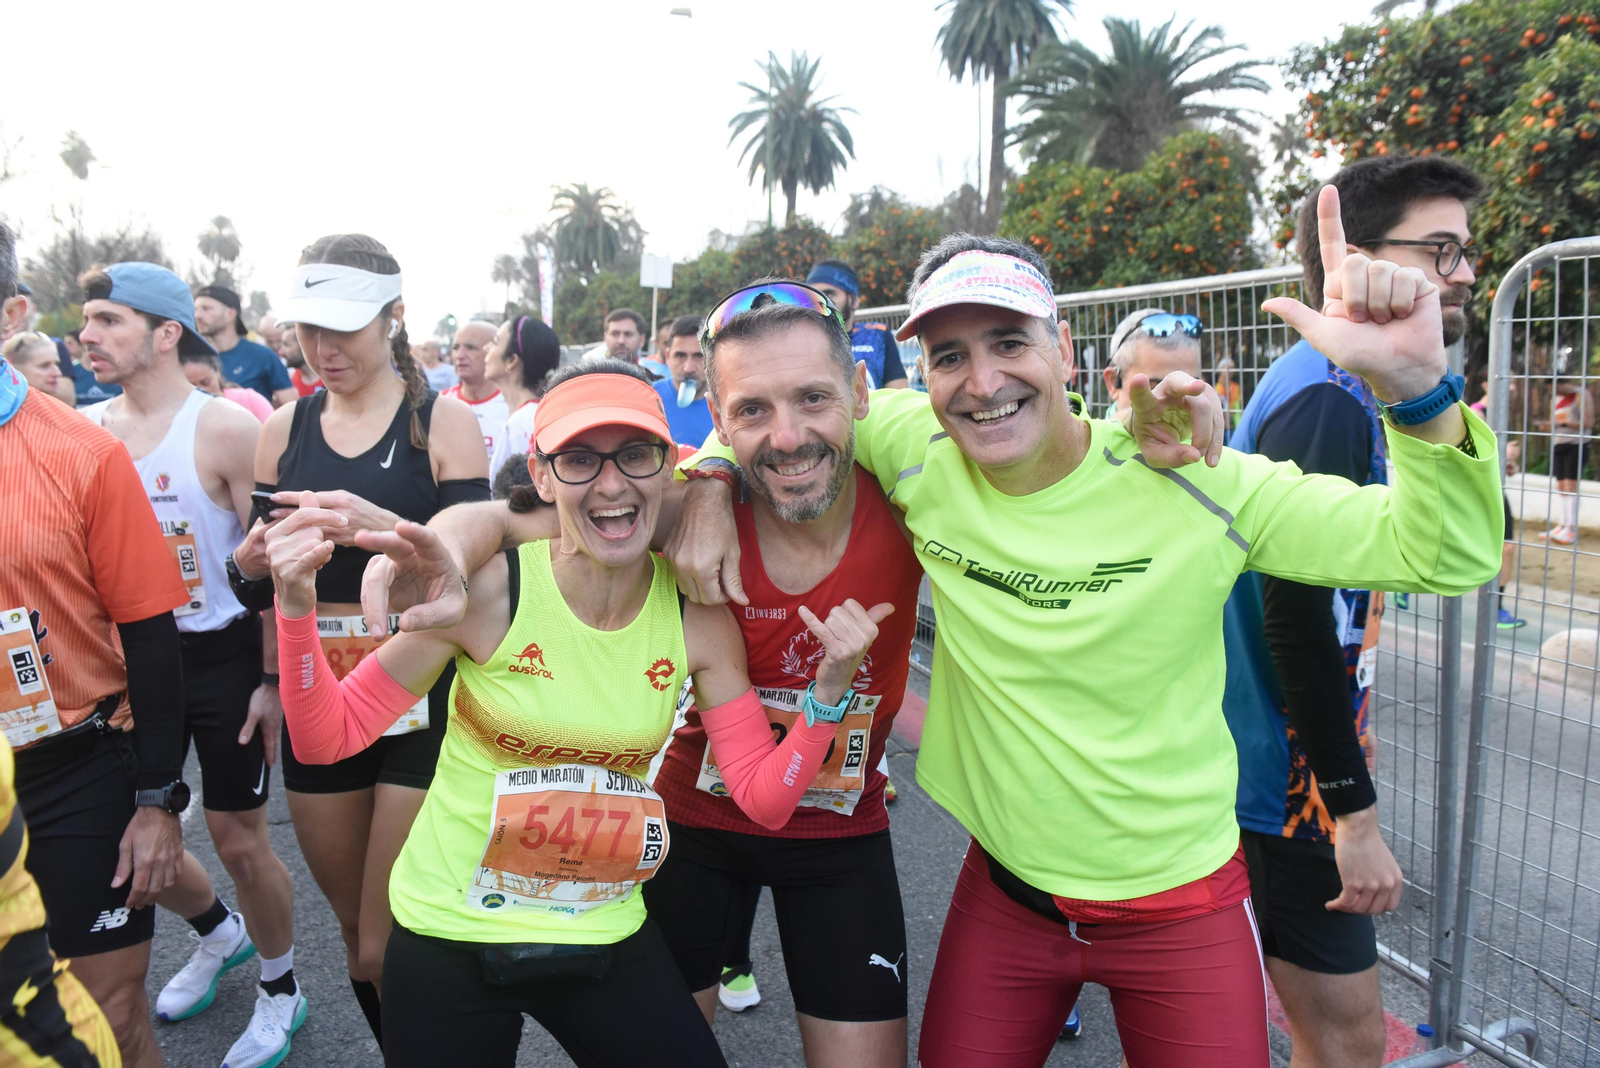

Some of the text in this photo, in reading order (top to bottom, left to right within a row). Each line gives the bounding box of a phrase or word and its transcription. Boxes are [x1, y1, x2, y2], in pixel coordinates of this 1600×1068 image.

[1018, 592, 1062, 609] STORE
[301, 653, 315, 690] BTWIN
[508, 664, 554, 681] austral
[759, 689, 799, 706] MARATÓN
[782, 750, 804, 788] BTWIN
[508, 766, 647, 794] MEDIO MARATÓN SEVILLA
[494, 824, 506, 845] CAJÓN
[519, 805, 631, 858] 5477
[559, 857, 584, 866] Reme
[534, 871, 571, 880] Mogedano
[549, 906, 575, 915] HOKA
